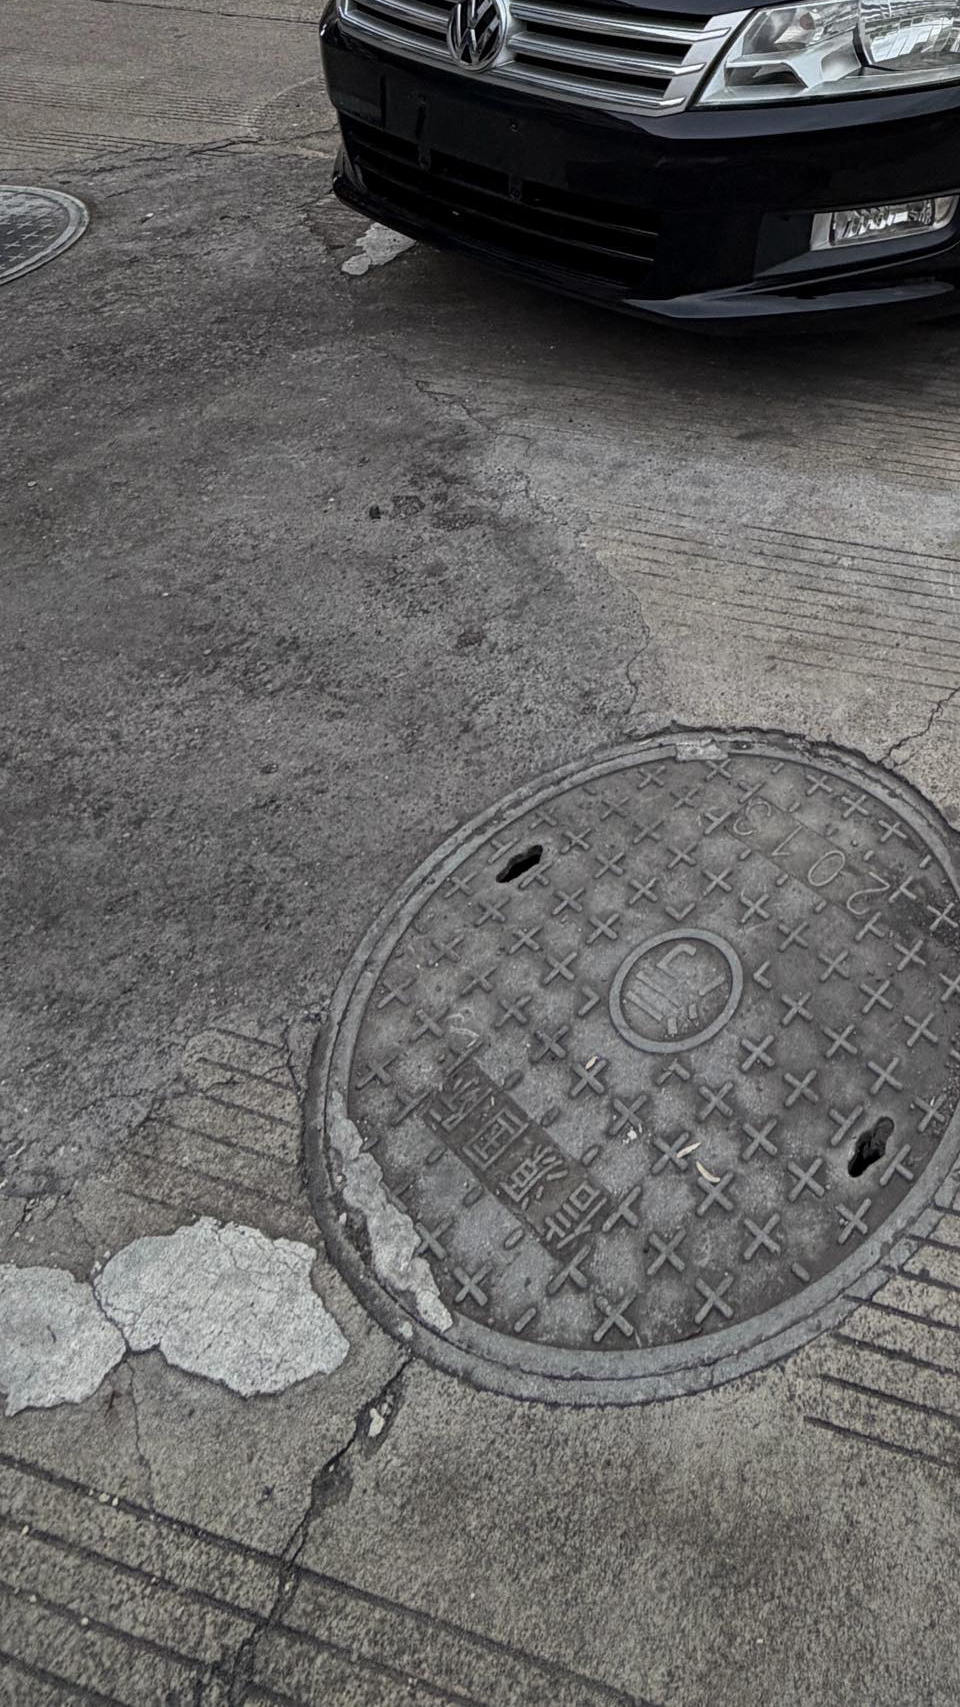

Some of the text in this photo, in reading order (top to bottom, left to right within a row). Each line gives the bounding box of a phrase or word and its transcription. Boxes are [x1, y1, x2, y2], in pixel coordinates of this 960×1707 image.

[733, 800, 891, 916] 2013
[429, 1077, 609, 1249] 信源国际
